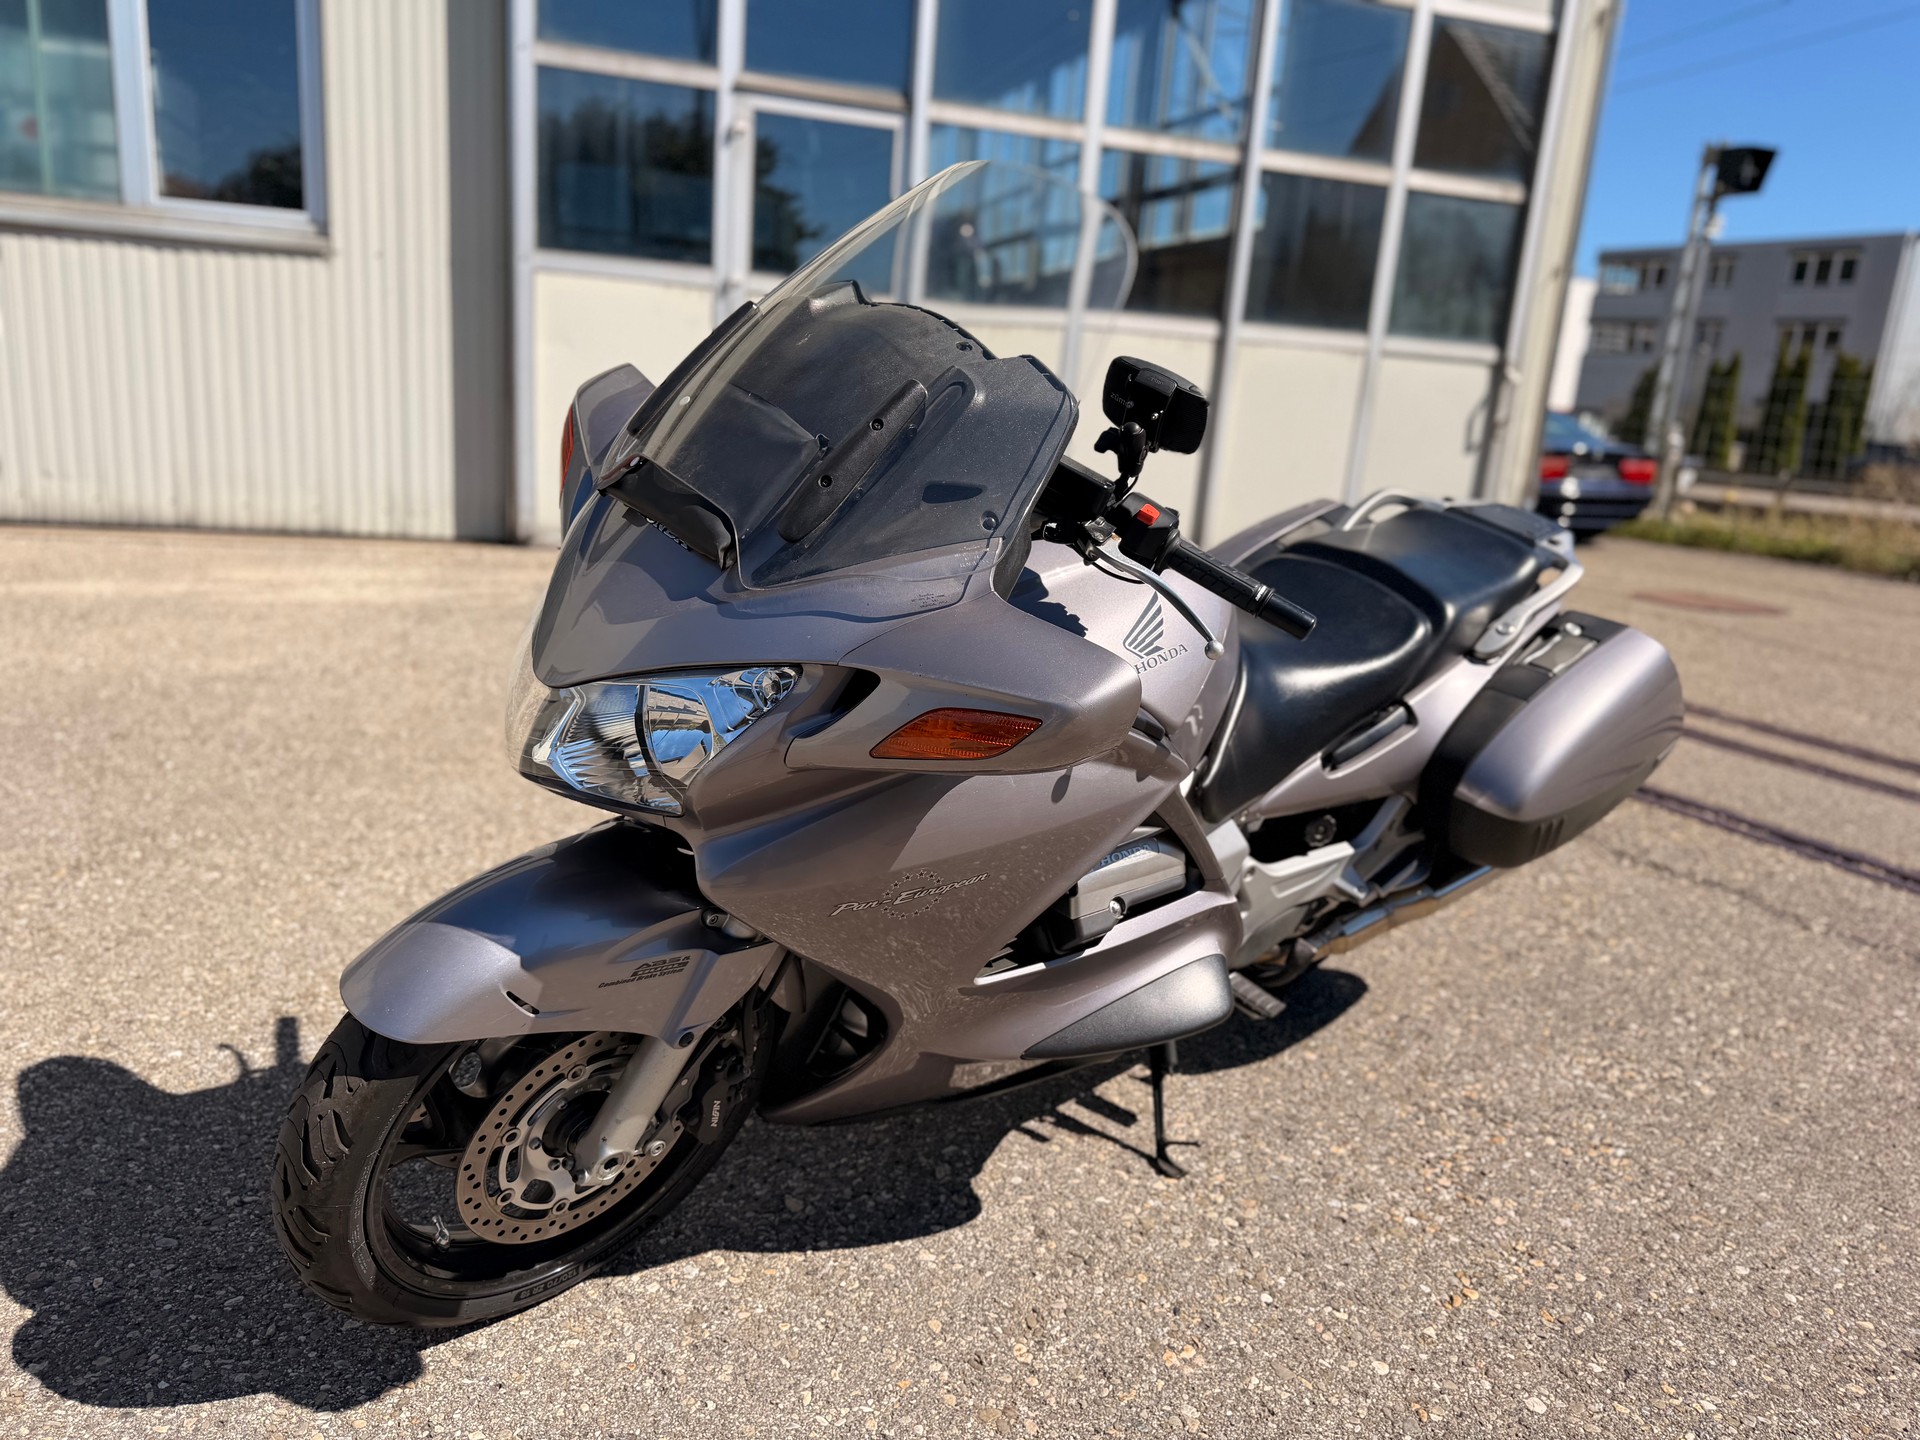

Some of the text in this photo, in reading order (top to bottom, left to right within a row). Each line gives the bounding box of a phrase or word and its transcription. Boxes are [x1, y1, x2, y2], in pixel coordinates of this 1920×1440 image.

[1134, 643, 1188, 675] HONDA
[1100, 844, 1152, 867] HONDA
[828, 872, 990, 918] Pan-European
[598, 976, 636, 988] Combined
[658, 968, 684, 977] System
